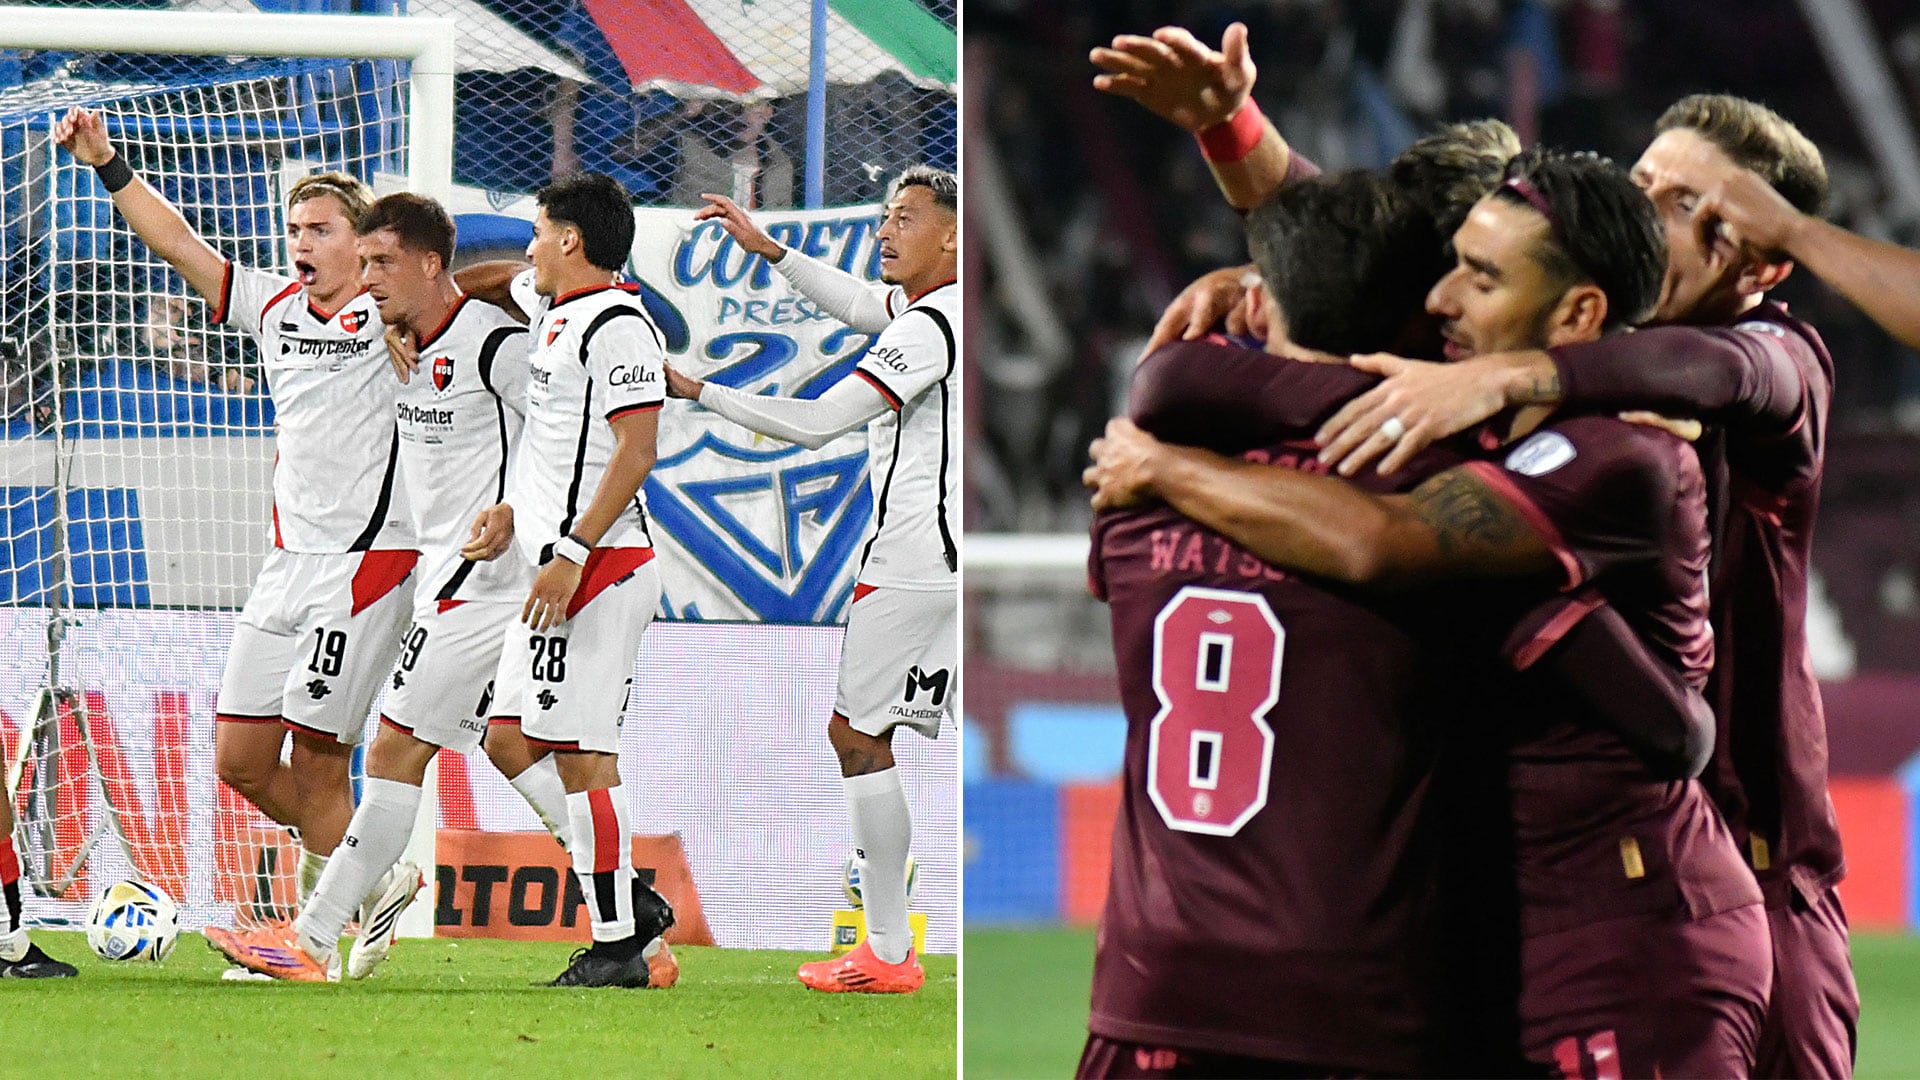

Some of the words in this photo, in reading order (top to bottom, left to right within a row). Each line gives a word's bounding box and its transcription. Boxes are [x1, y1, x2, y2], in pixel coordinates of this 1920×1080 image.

[397, 402, 454, 426] CityCenter
[308, 627, 347, 677] 19
[530, 635, 567, 683] 28
[1147, 585, 1286, 838] 8
